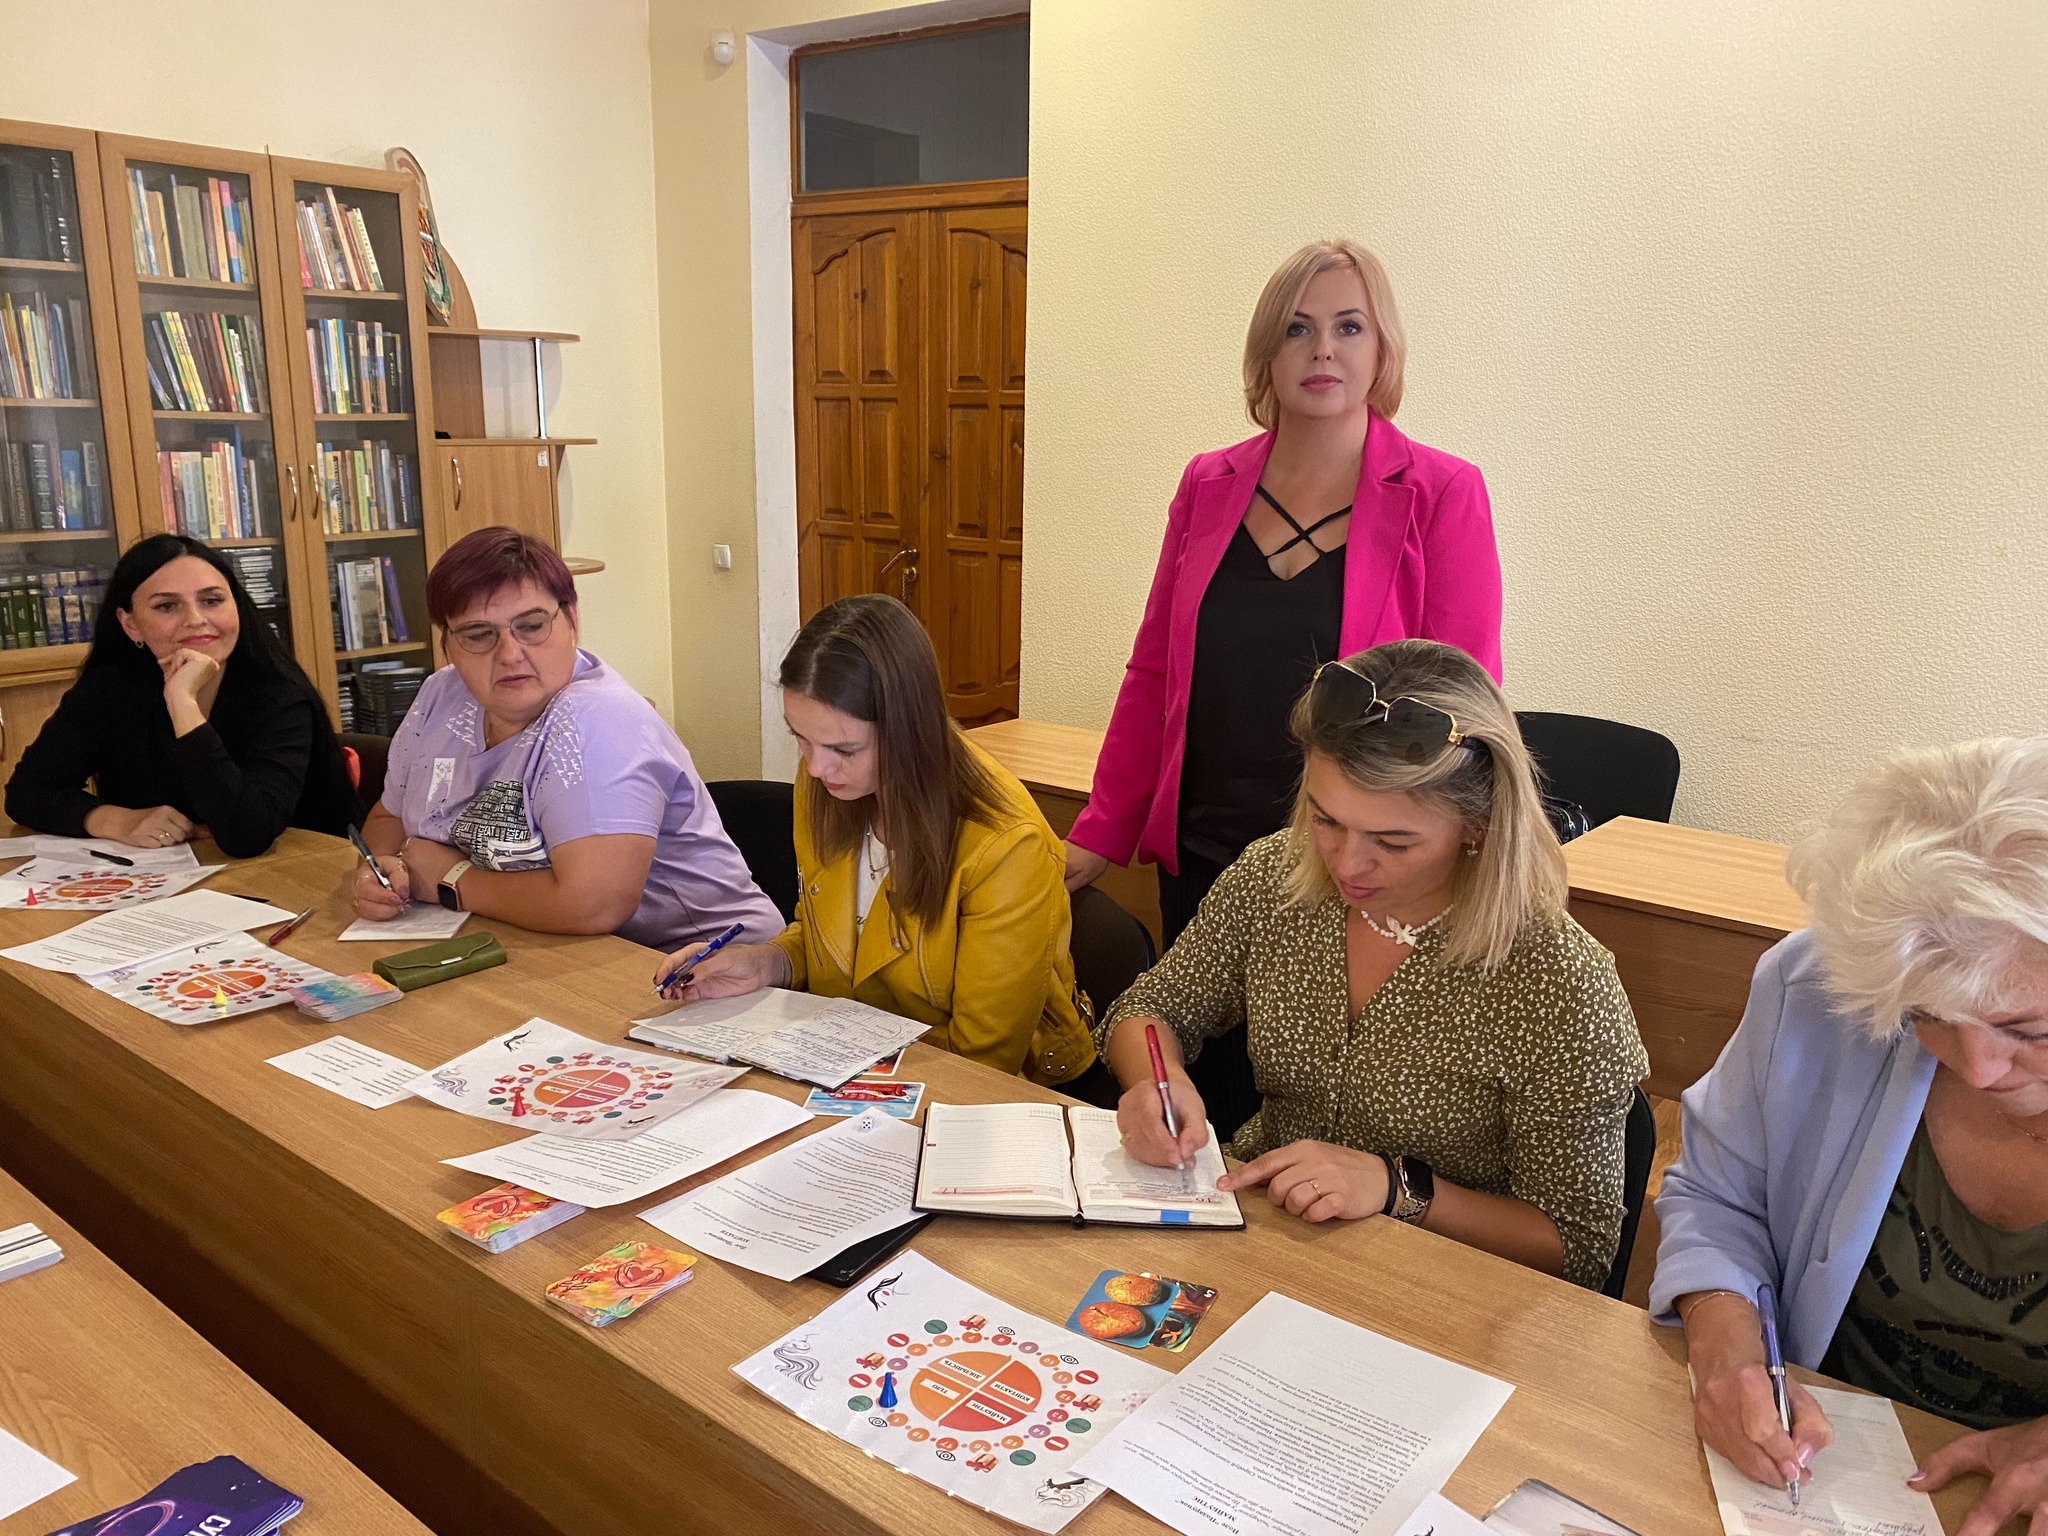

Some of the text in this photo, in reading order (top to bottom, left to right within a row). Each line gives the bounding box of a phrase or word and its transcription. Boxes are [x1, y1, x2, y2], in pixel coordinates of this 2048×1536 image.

[484, 826, 495, 837] EAT
[514, 829, 528, 840] EAT
[1043, 1357, 1055, 1365] 10
[994, 1383, 1031, 1402] КОНТАКТИ
[1060, 1393, 1071, 1401] 12
[1033, 1428, 1045, 1436] 14
[941, 1441, 954, 1449] 17
[1005, 1439, 1017, 1447] 15
